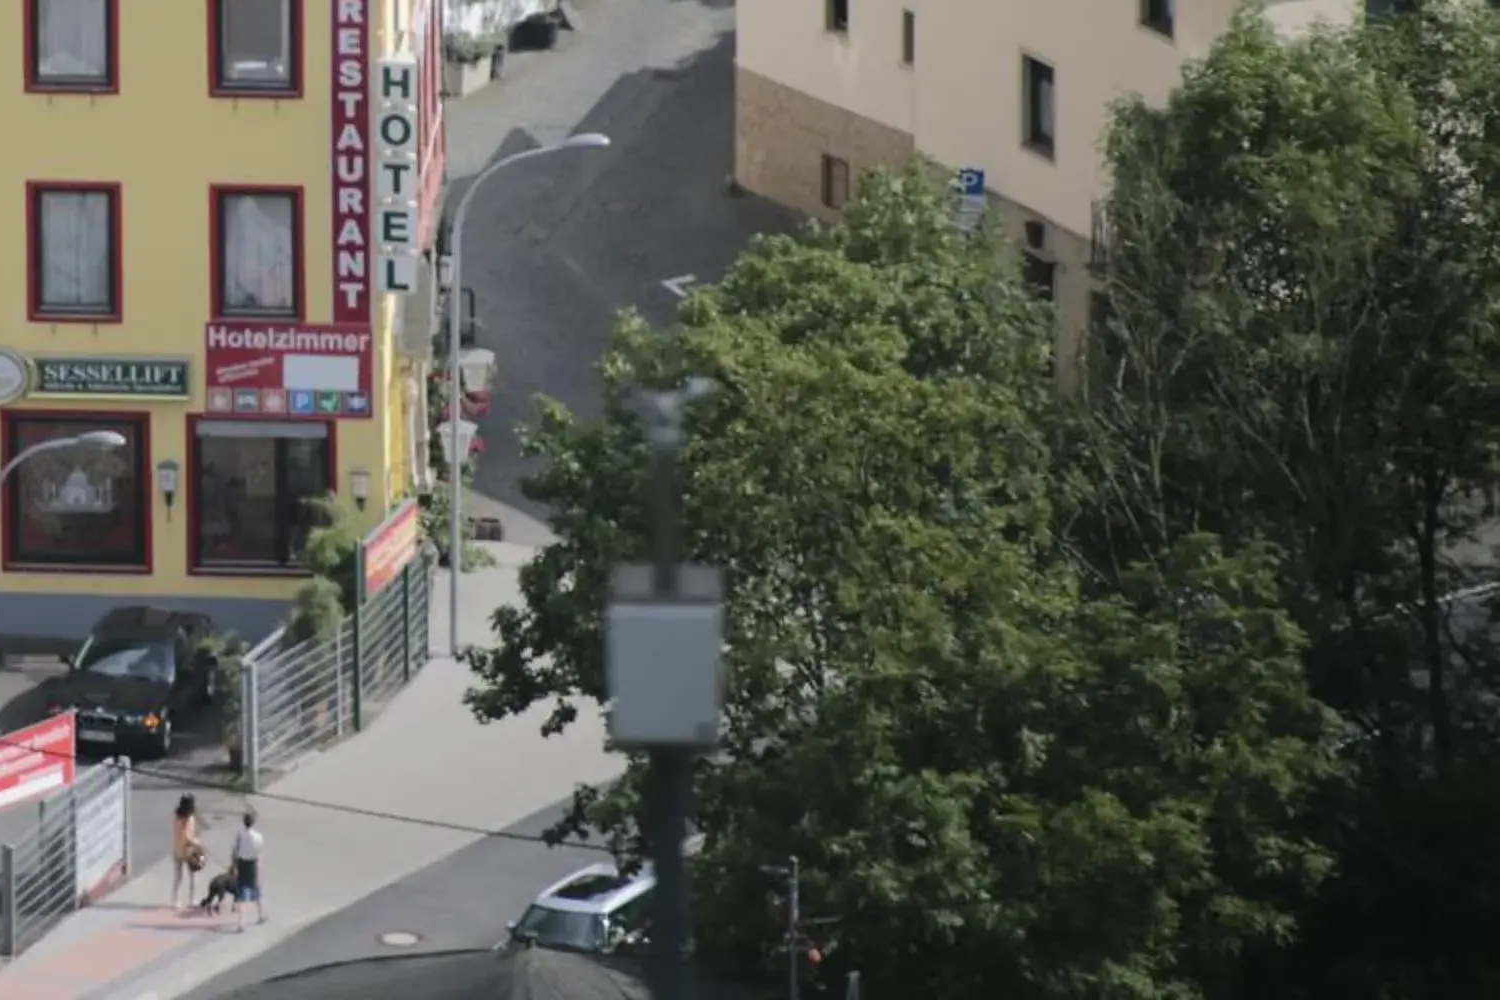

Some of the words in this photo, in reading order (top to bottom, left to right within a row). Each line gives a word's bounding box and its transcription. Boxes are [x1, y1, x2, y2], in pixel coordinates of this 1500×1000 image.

[380, 65, 410, 291] HOTEL
[208, 325, 370, 352] Hotelzimmer
[43, 364, 183, 383] SESSELLIFT
